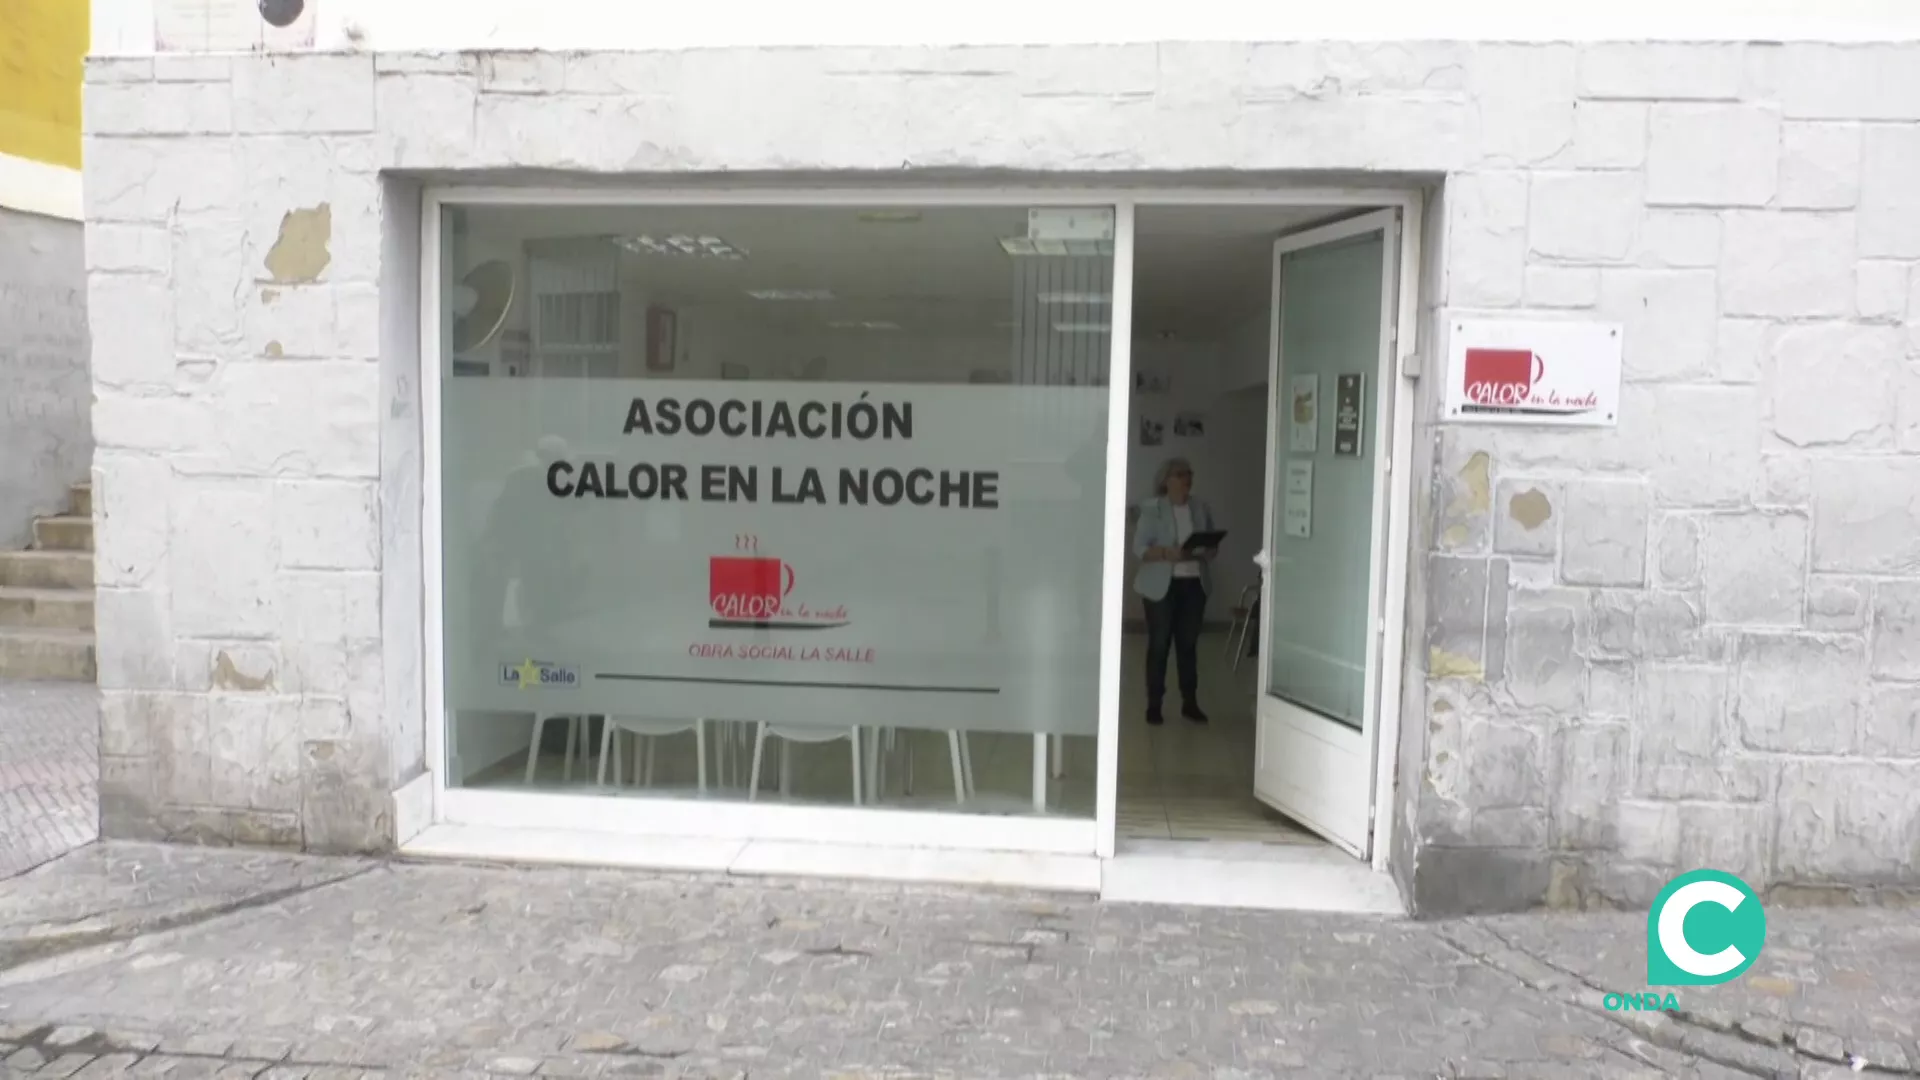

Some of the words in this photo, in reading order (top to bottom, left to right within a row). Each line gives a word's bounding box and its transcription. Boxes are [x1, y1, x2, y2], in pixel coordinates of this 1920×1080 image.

[1467, 381, 1529, 405] CALOR
[623, 390, 913, 441] ASOCIACIÓN
[547, 460, 689, 501] CALOR
[701, 465, 758, 503] EN
[771, 466, 827, 505] LA
[838, 467, 999, 510] NOCHE
[711, 592, 780, 618] CALOR
[688, 643, 734, 659] OBRA
[737, 644, 798, 662] SOCIAL
[800, 646, 820, 662] LA
[824, 646, 877, 664] SALLE
[503, 665, 520, 681] La
[540, 667, 576, 684] Salle
